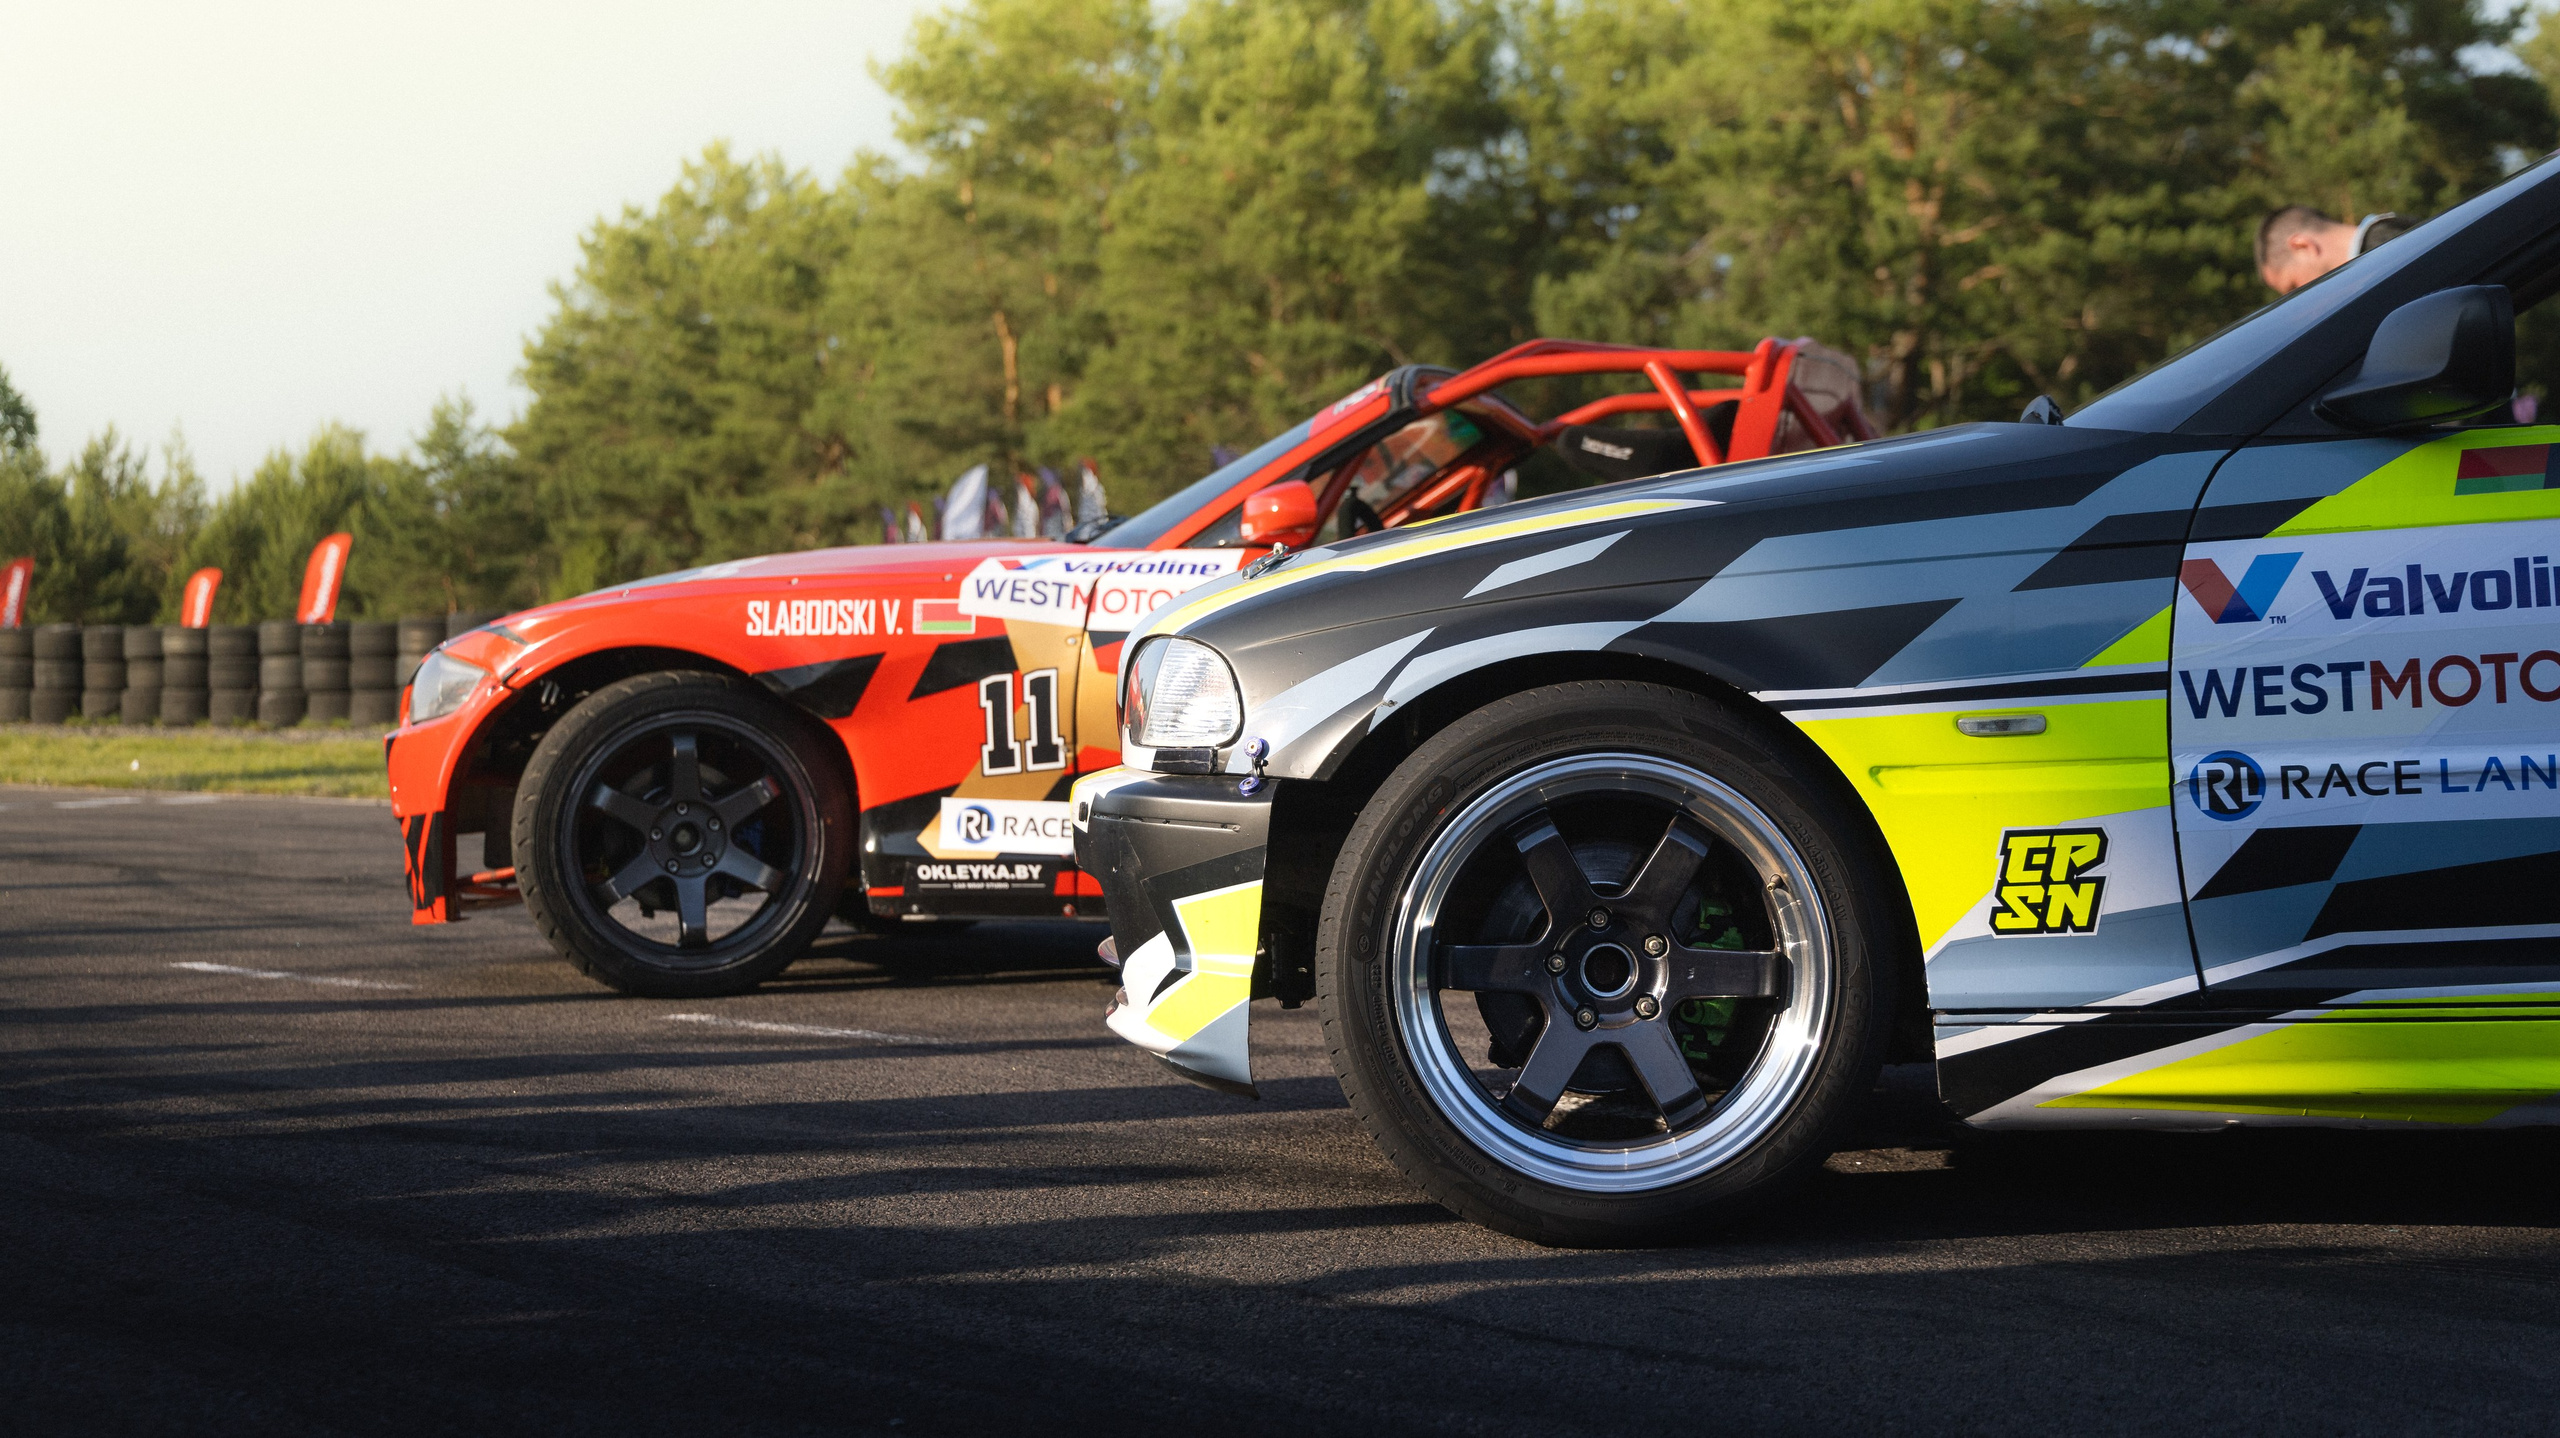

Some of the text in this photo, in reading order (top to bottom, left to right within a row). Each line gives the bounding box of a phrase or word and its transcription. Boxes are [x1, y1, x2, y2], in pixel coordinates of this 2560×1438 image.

[1065, 559, 1221, 577] Valvoline
[2311, 555, 2560, 620] Valvoli
[976, 578, 1188, 614] WESTMOTO
[746, 599, 904, 637] SLABODSKI V.
[980, 667, 1066, 777] 11
[2280, 760, 2423, 800] RACE
[2440, 754, 2558, 793] LAN
[917, 864, 1042, 881] OKLEYKA.BY
[1361, 783, 1445, 926] LINGLONG
